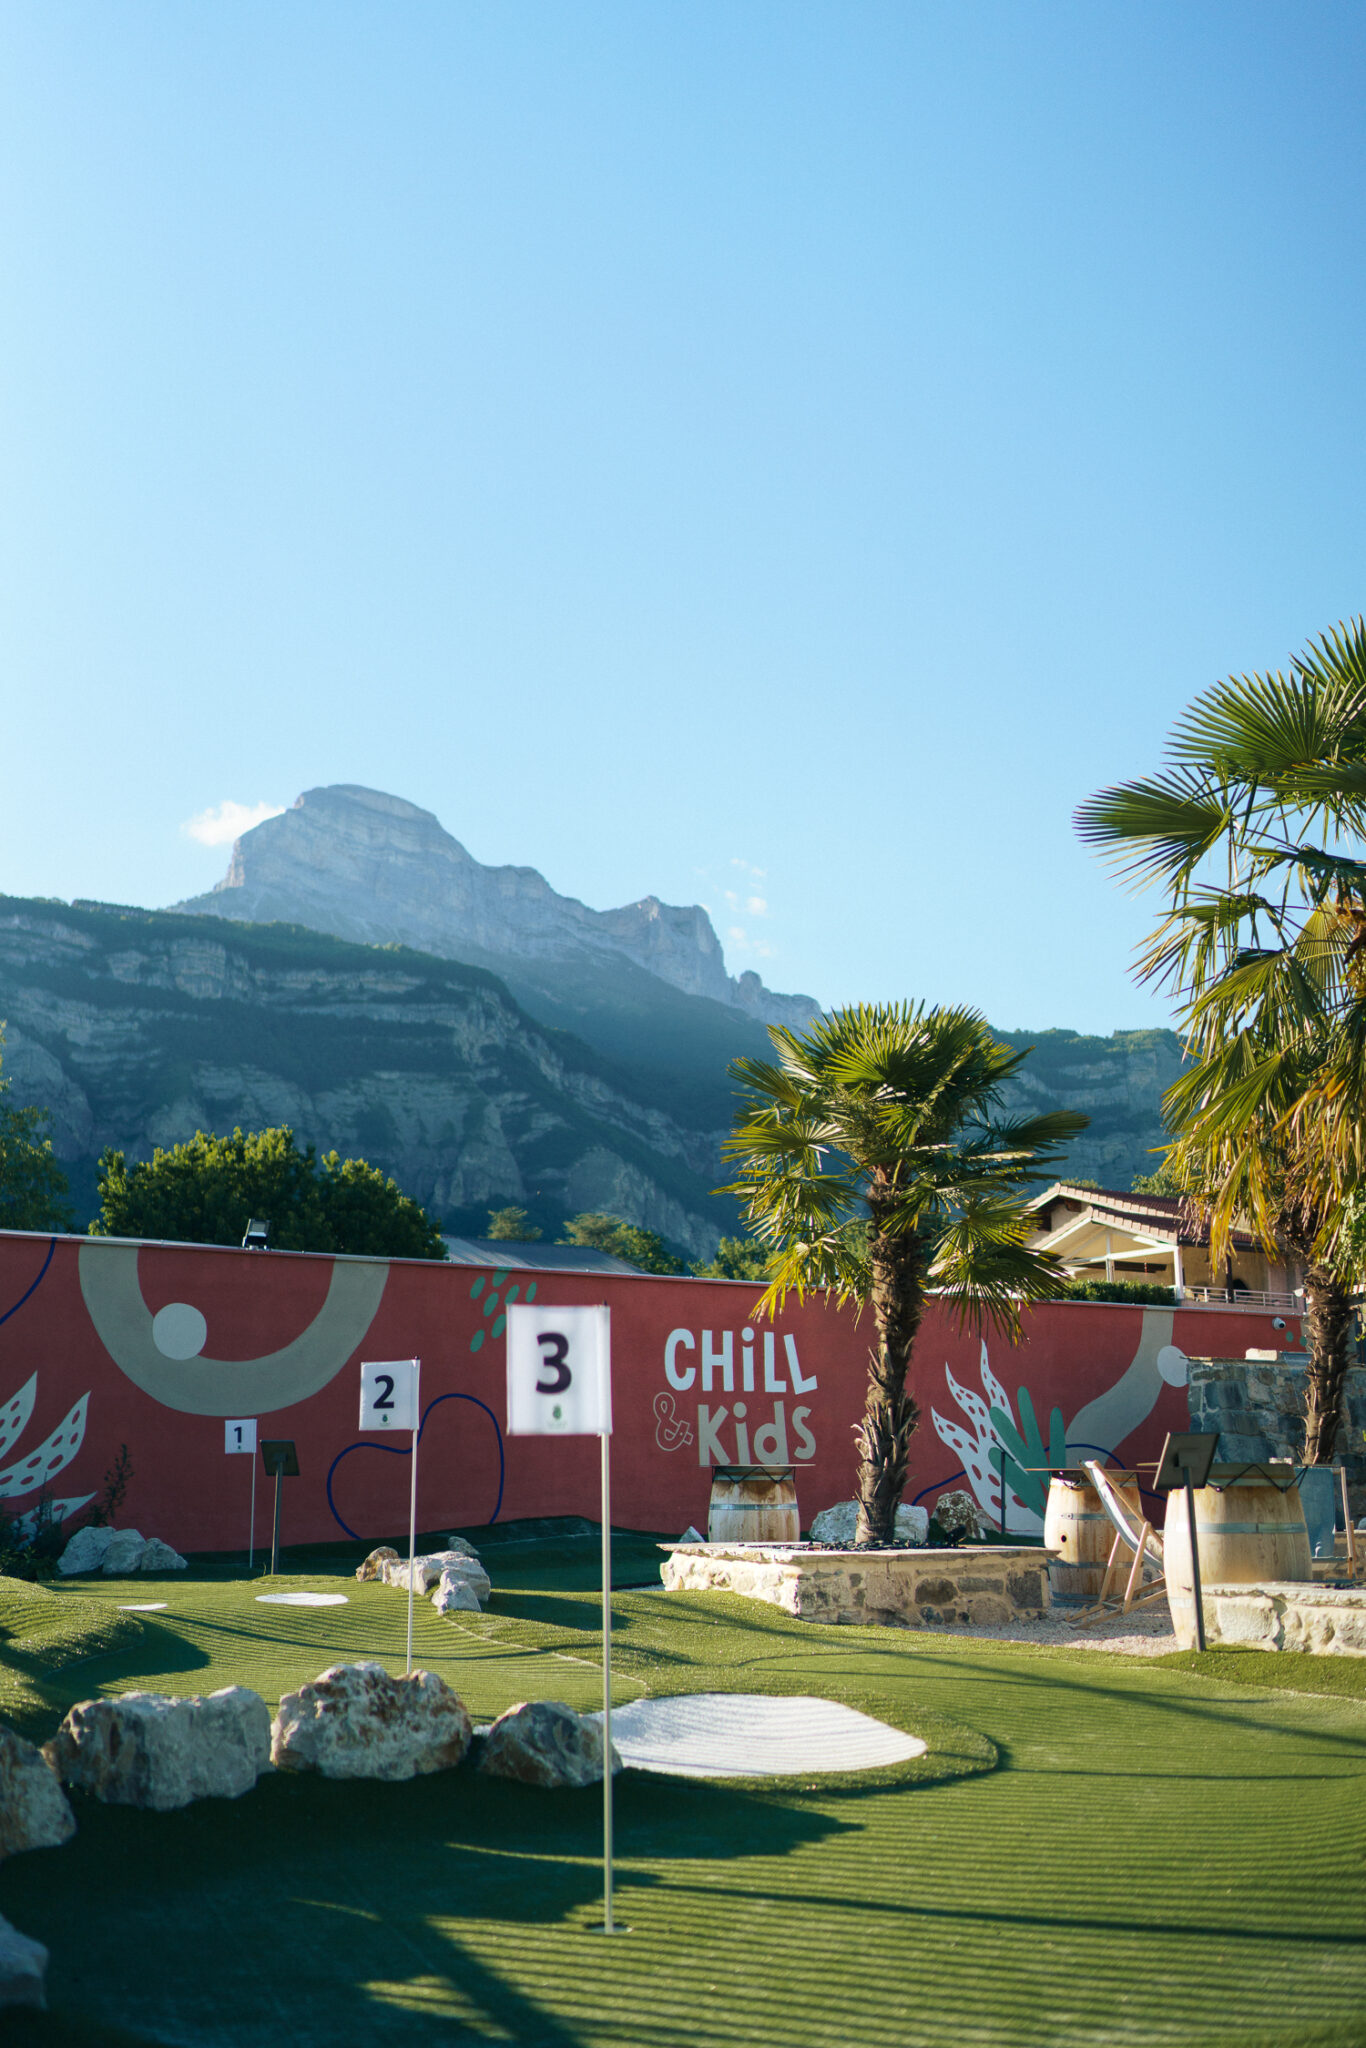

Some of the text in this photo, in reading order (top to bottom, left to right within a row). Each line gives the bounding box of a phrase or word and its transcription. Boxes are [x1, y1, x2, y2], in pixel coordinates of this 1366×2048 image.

[536, 1331, 572, 1395] 3
[373, 1374, 395, 1409] 2
[234, 1426, 242, 1443] 1
[653, 1392, 694, 1452] &
